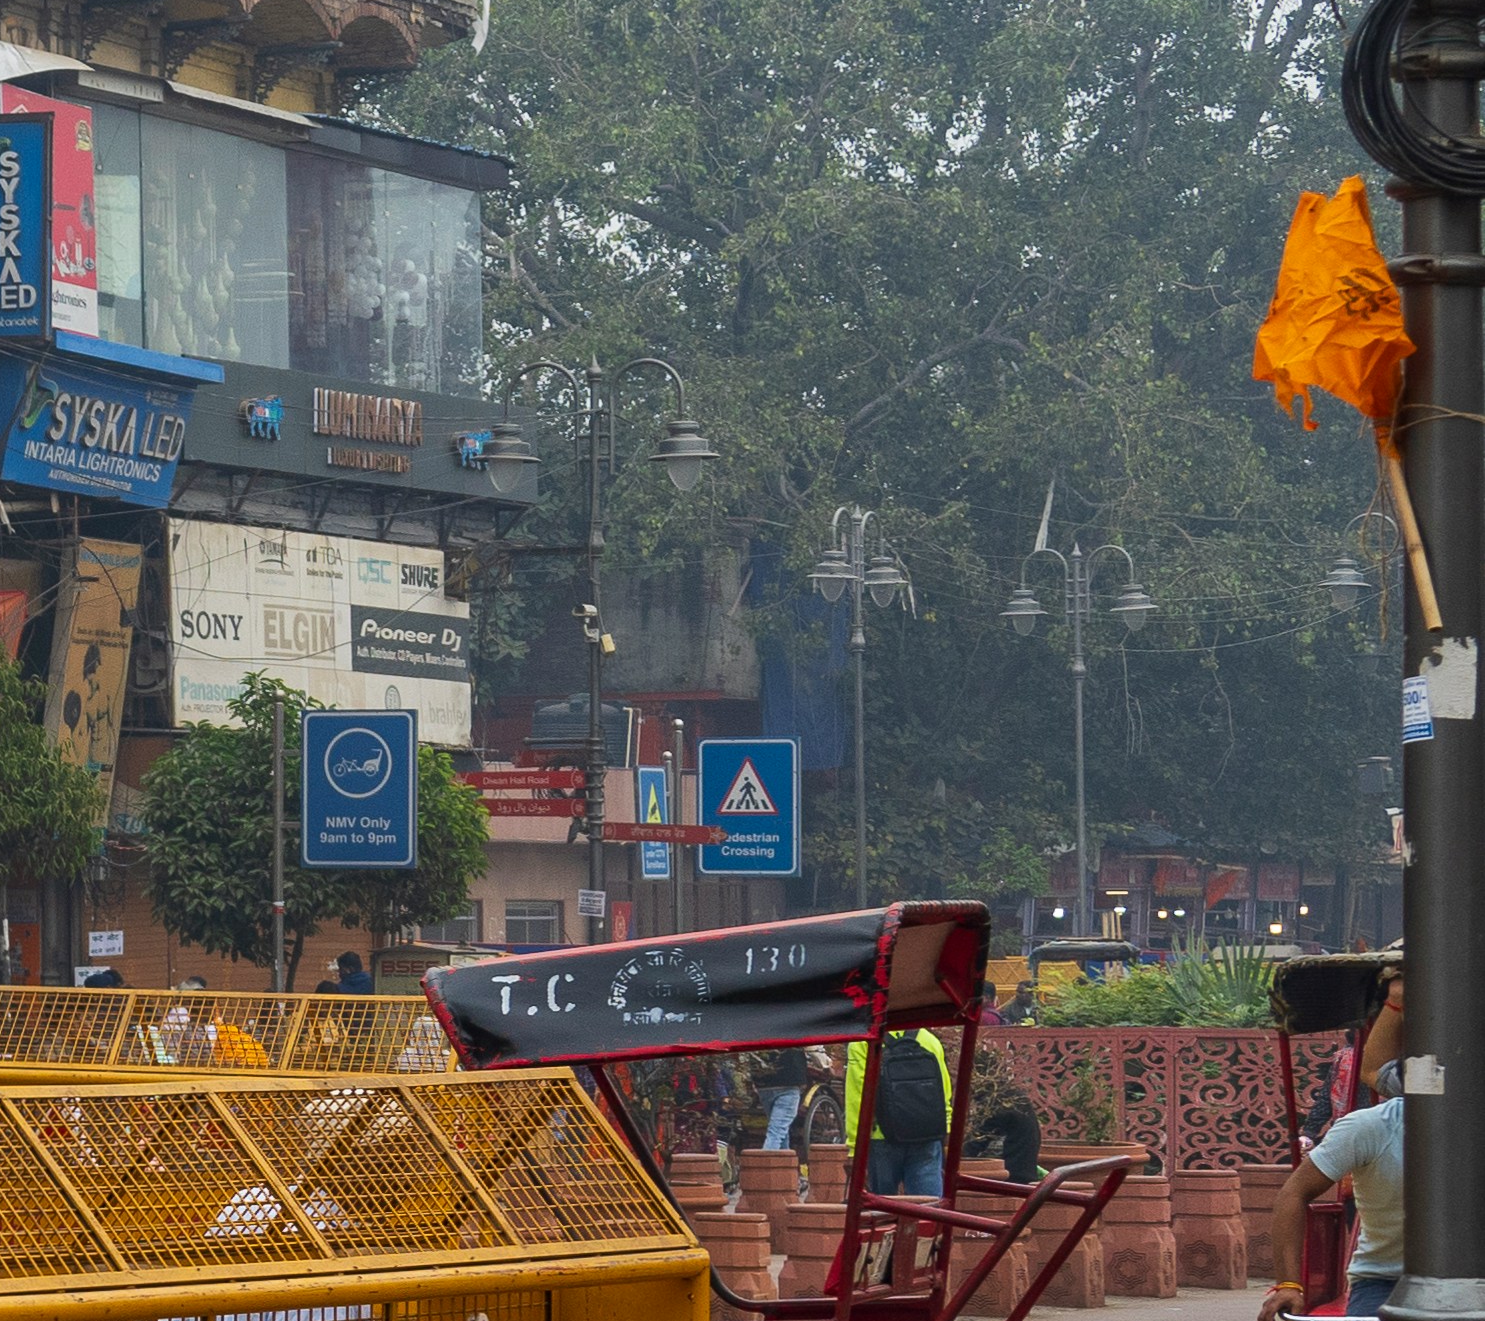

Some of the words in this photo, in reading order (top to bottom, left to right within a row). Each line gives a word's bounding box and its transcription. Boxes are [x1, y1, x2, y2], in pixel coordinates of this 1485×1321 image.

[48, 392, 138, 455] SYSKA
[139, 412, 186, 462] LED
[24, 440, 77, 468] INTARIA
[78, 451, 162, 483] LIGHTRONICS
[358, 557, 392, 584] QSC
[401, 563, 439, 589] SHURE
[180, 610, 244, 641] SONY
[264, 610, 335, 656] ELGIN
[360, 618, 436, 646] Pioneer
[527, 773, 550, 785] Road
[325, 816, 357, 829] NMV
[360, 816, 392, 831] Only
[319, 831, 348, 844] 9am
[350, 832, 365, 844] to
[367, 831, 397, 846] 9pm
[724, 832, 780, 843] edestrian
[720, 845, 776, 859] Crossing
[744, 944, 807, 975] 130
